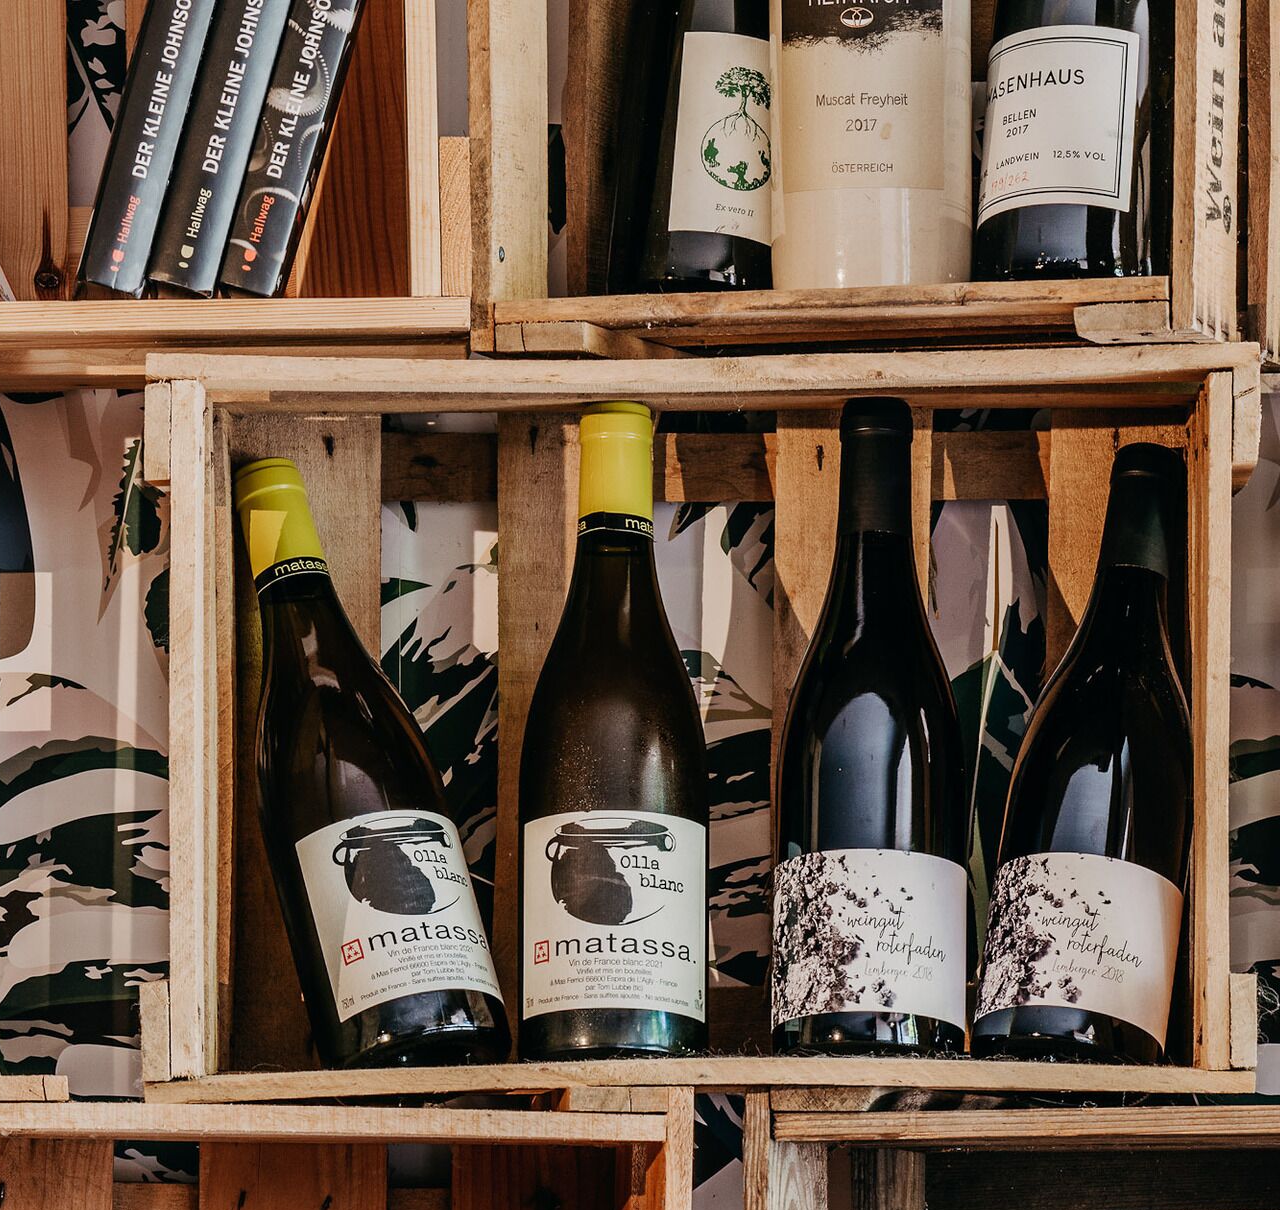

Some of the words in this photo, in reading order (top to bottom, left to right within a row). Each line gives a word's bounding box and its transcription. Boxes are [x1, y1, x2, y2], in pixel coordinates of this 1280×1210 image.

[142, 70, 173, 137] KLEINE
[213, 60, 247, 131] KLEINE
[278, 71, 311, 138] KLEINE
[815, 93, 856, 107] Muscat
[860, 92, 908, 109] Freyheit
[845, 118, 878, 132] 2017
[1002, 108, 1037, 126] BELLEN
[1006, 124, 1029, 138] 2017
[131, 141, 155, 180] DER
[201, 134, 227, 174] DER
[266, 141, 291, 180] DER
[996, 151, 1040, 170] LANDWEIN
[1085, 151, 1106, 161] VOL
[1204, 69, 1225, 228] Wein
[831, 161, 894, 173] ÖSTERREICH
[116, 194, 141, 244] Hallwag
[186, 187, 212, 239] Hallwag
[249, 194, 275, 243] Hallwag
[715, 203, 726, 212] Ex
[433, 866, 468, 887] blanc
[639, 873, 684, 894] blanc
[368, 921, 490, 952] matassa
[846, 906, 904, 936] weingut
[1041, 907, 1100, 938] weingut
[876, 931, 946, 965] roterfaden
[1066, 930, 1143, 968] roterfaden
[1100, 965, 1124, 983] 2018
